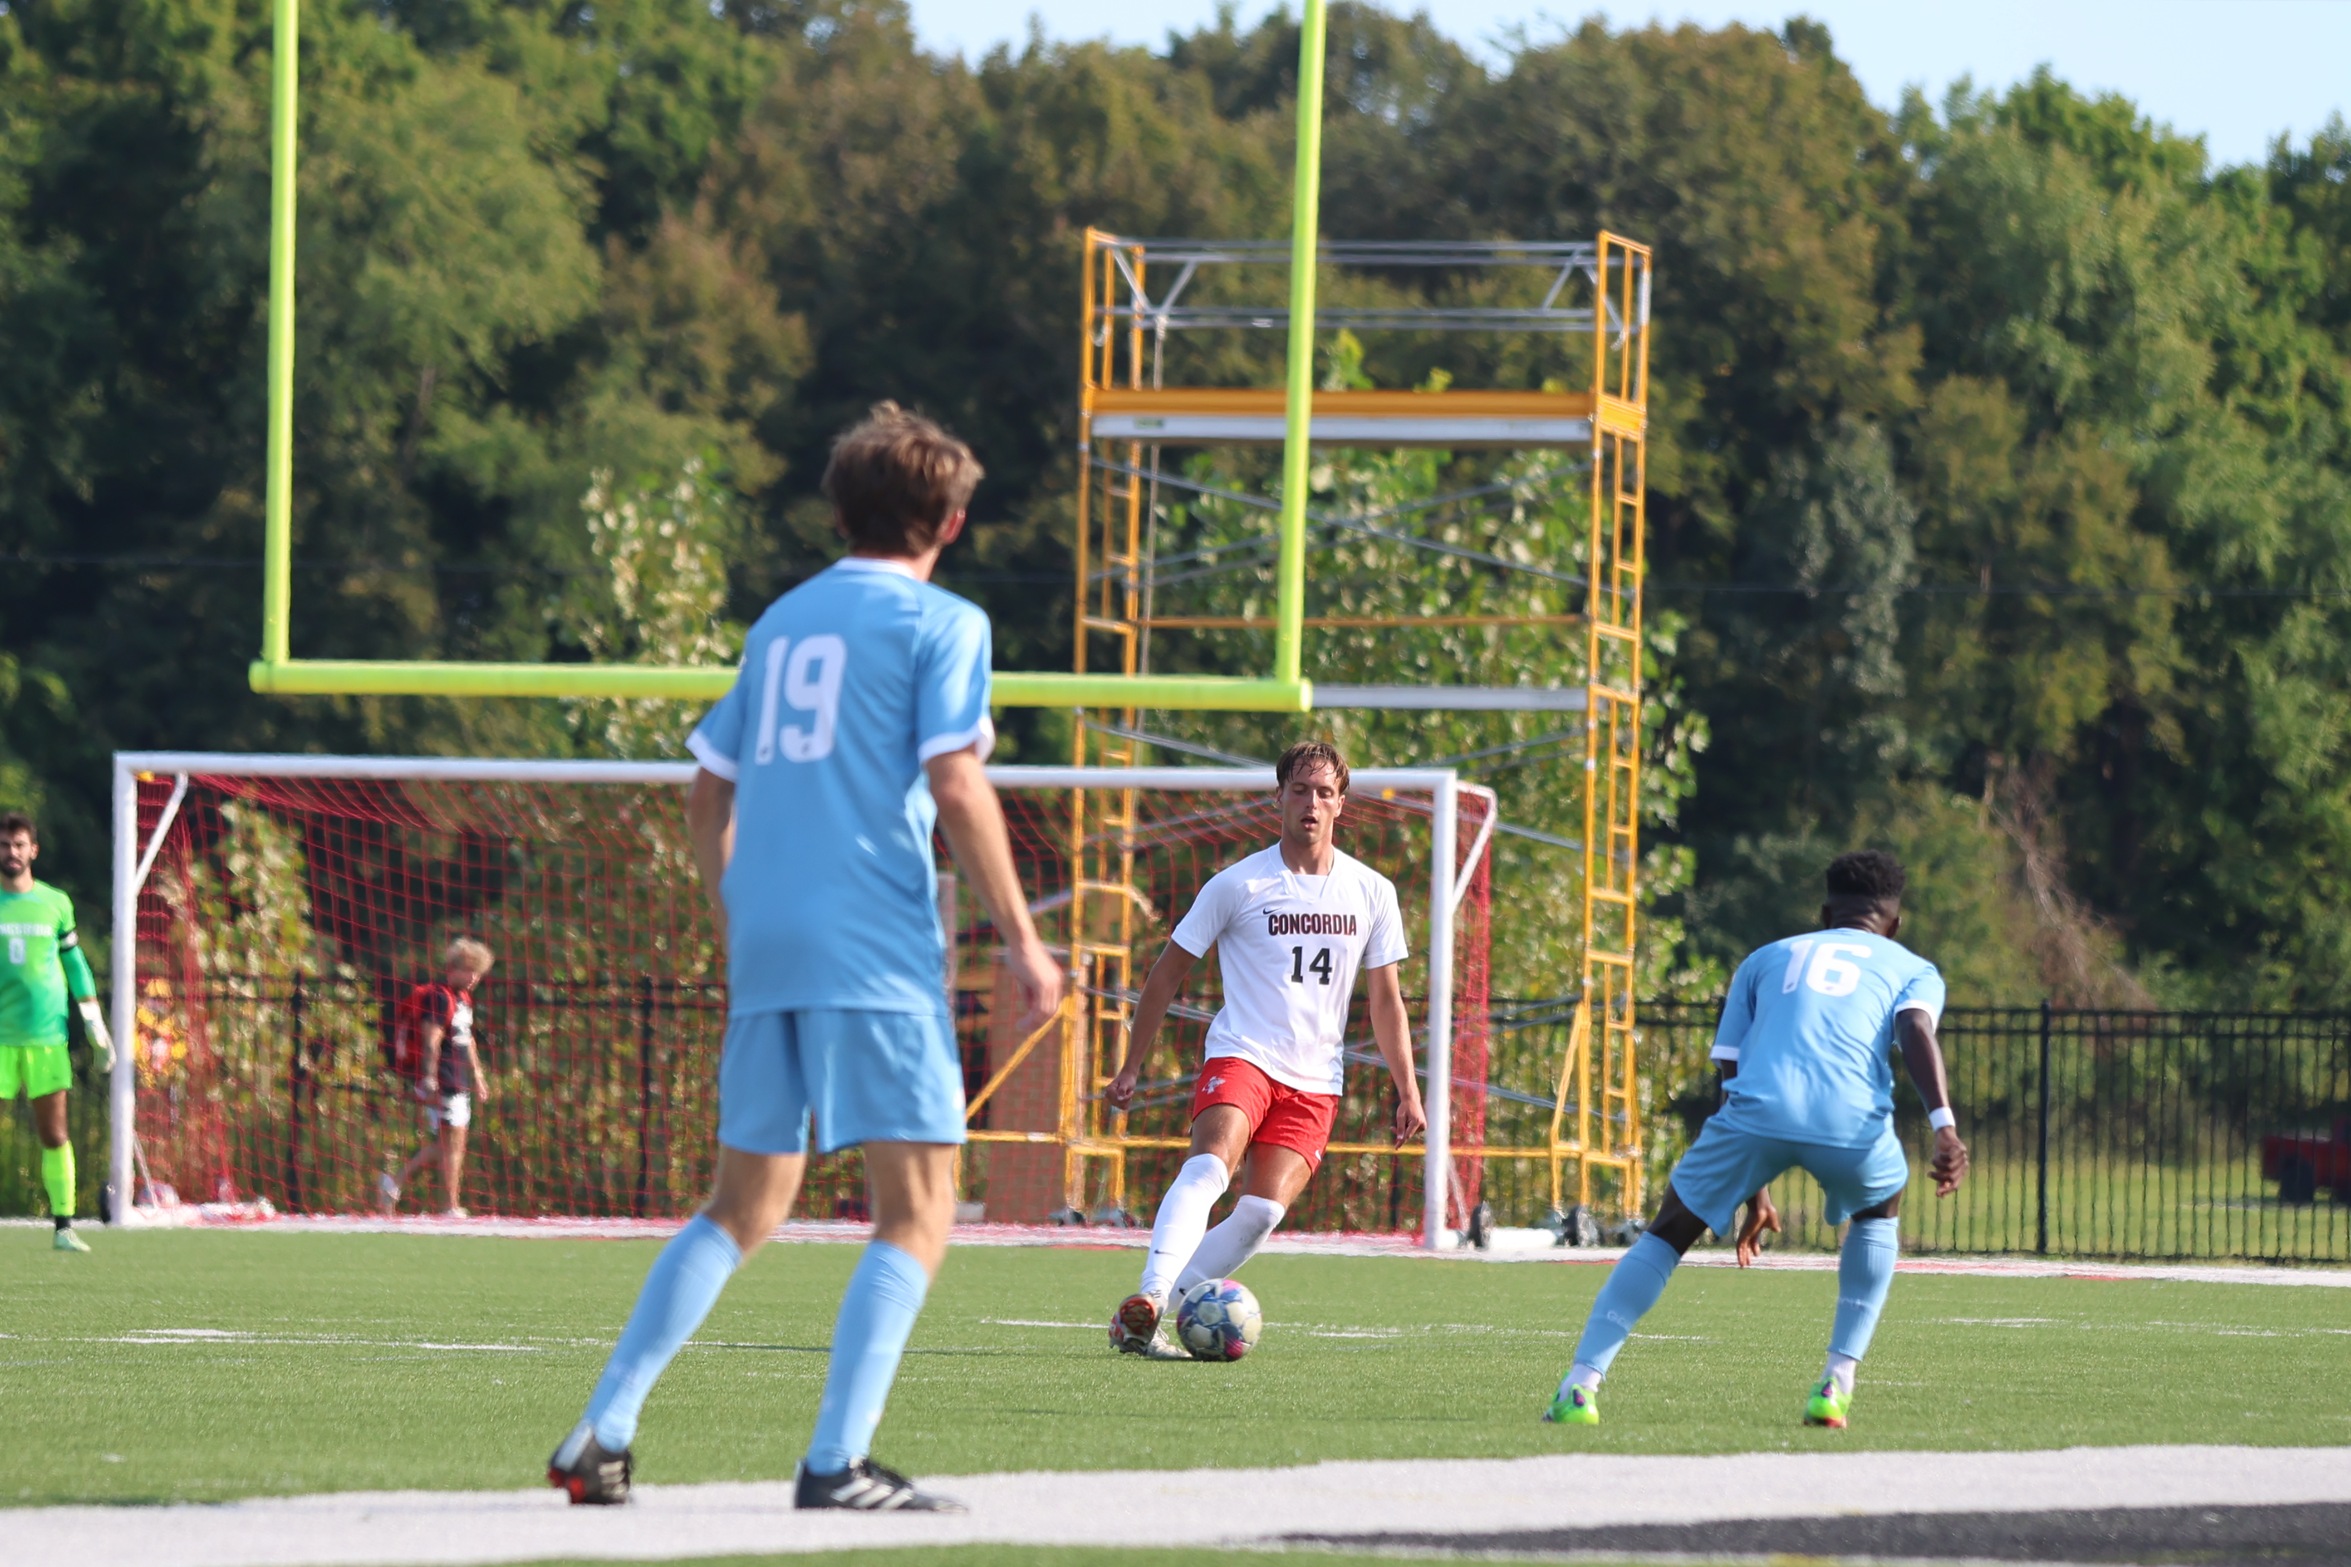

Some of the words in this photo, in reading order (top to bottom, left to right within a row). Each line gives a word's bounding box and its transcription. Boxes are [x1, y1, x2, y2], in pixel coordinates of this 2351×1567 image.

[755, 634, 847, 765] 19
[1268, 913, 1357, 936] CONCORDIA
[1291, 946, 1332, 985] 14
[1782, 940, 1872, 997] 16
